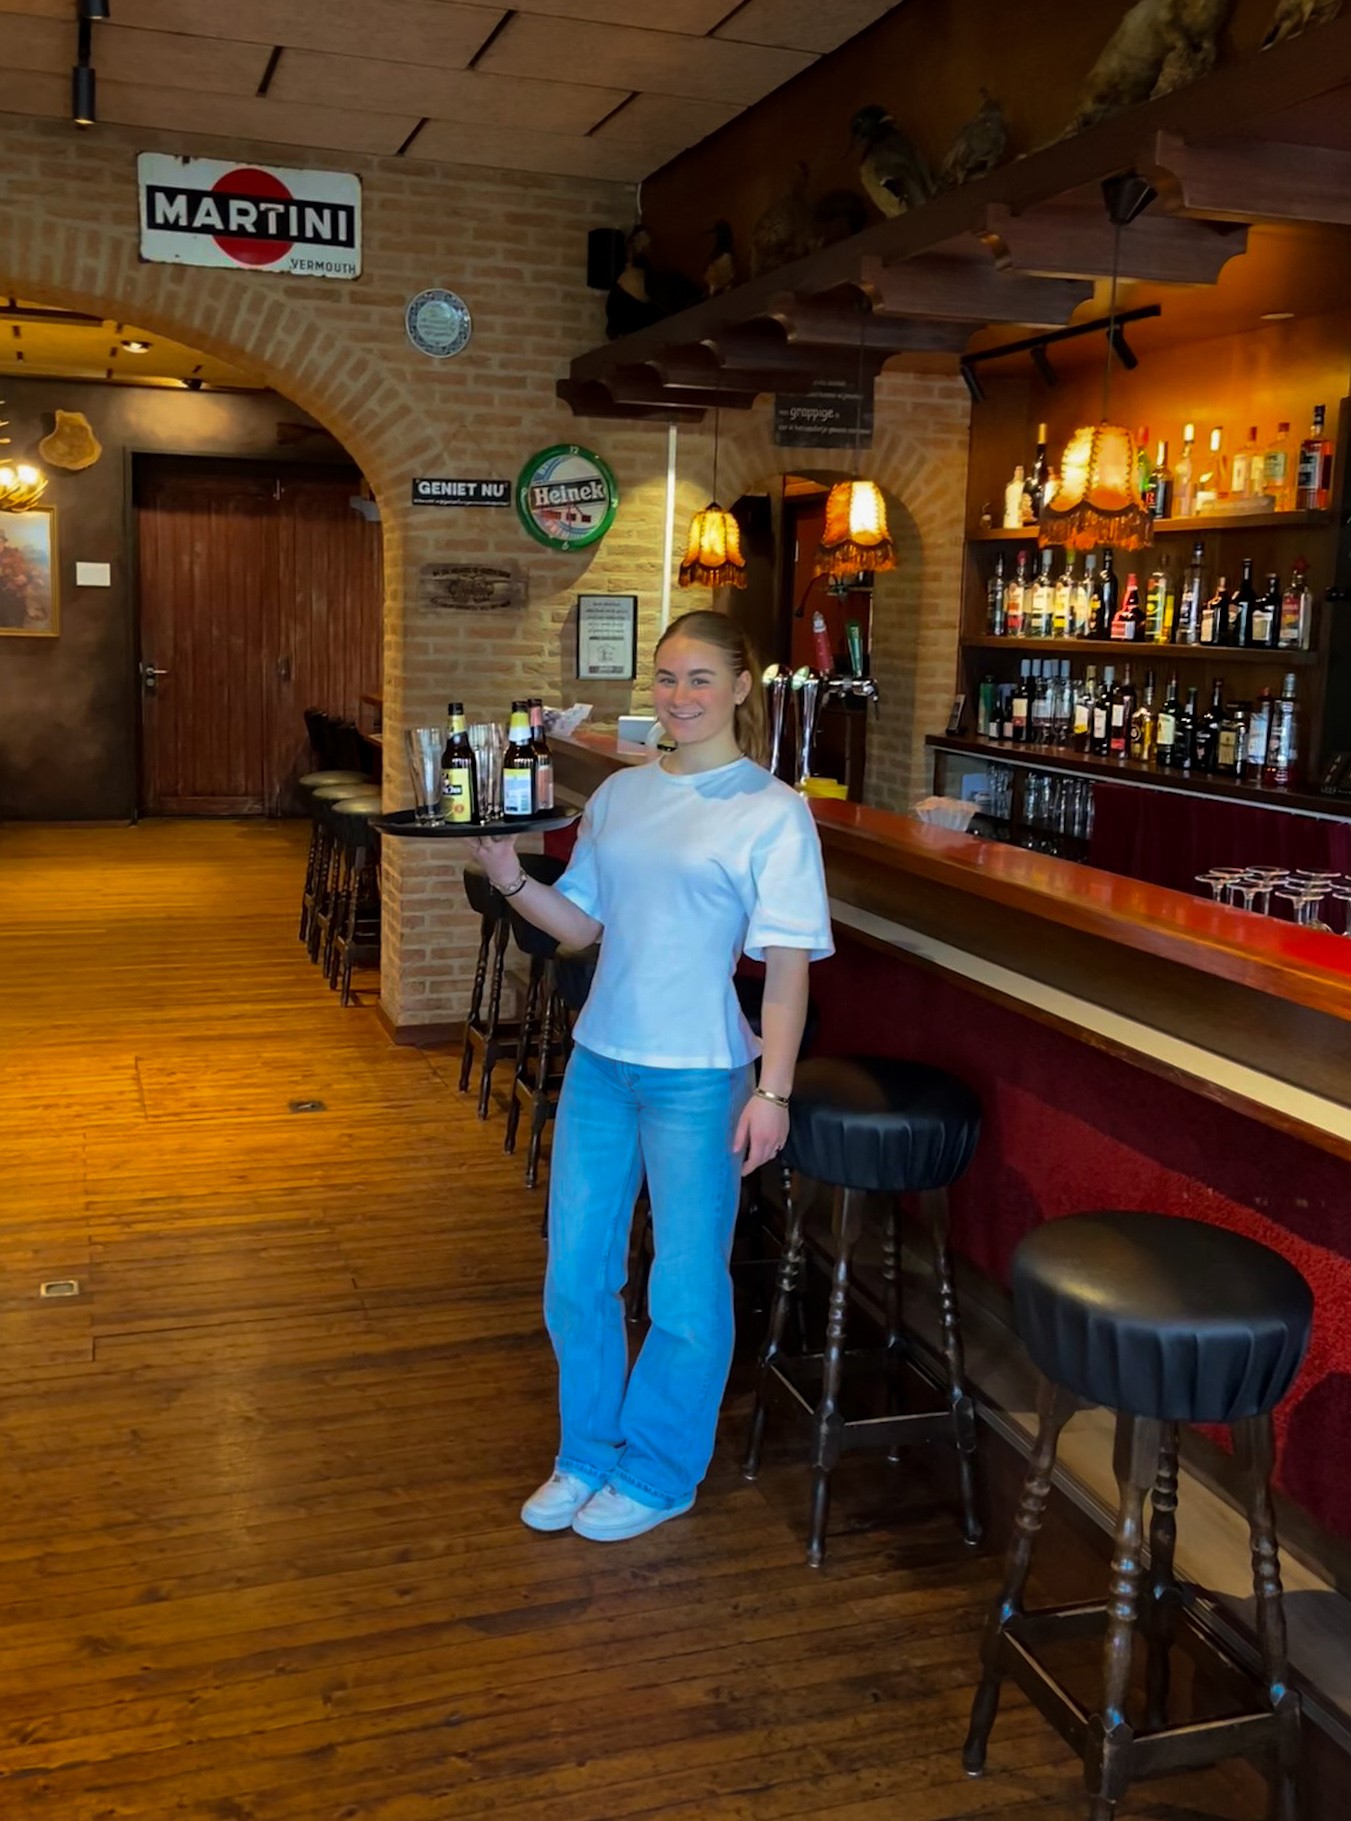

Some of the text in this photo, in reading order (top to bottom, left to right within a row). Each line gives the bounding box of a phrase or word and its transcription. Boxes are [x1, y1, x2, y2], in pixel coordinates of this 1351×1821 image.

[153, 191, 347, 242] MARTINI
[290, 258, 356, 274] VERMOUTH
[418, 481, 505, 498] GENIET NU
[533, 481, 607, 506] Heinek
